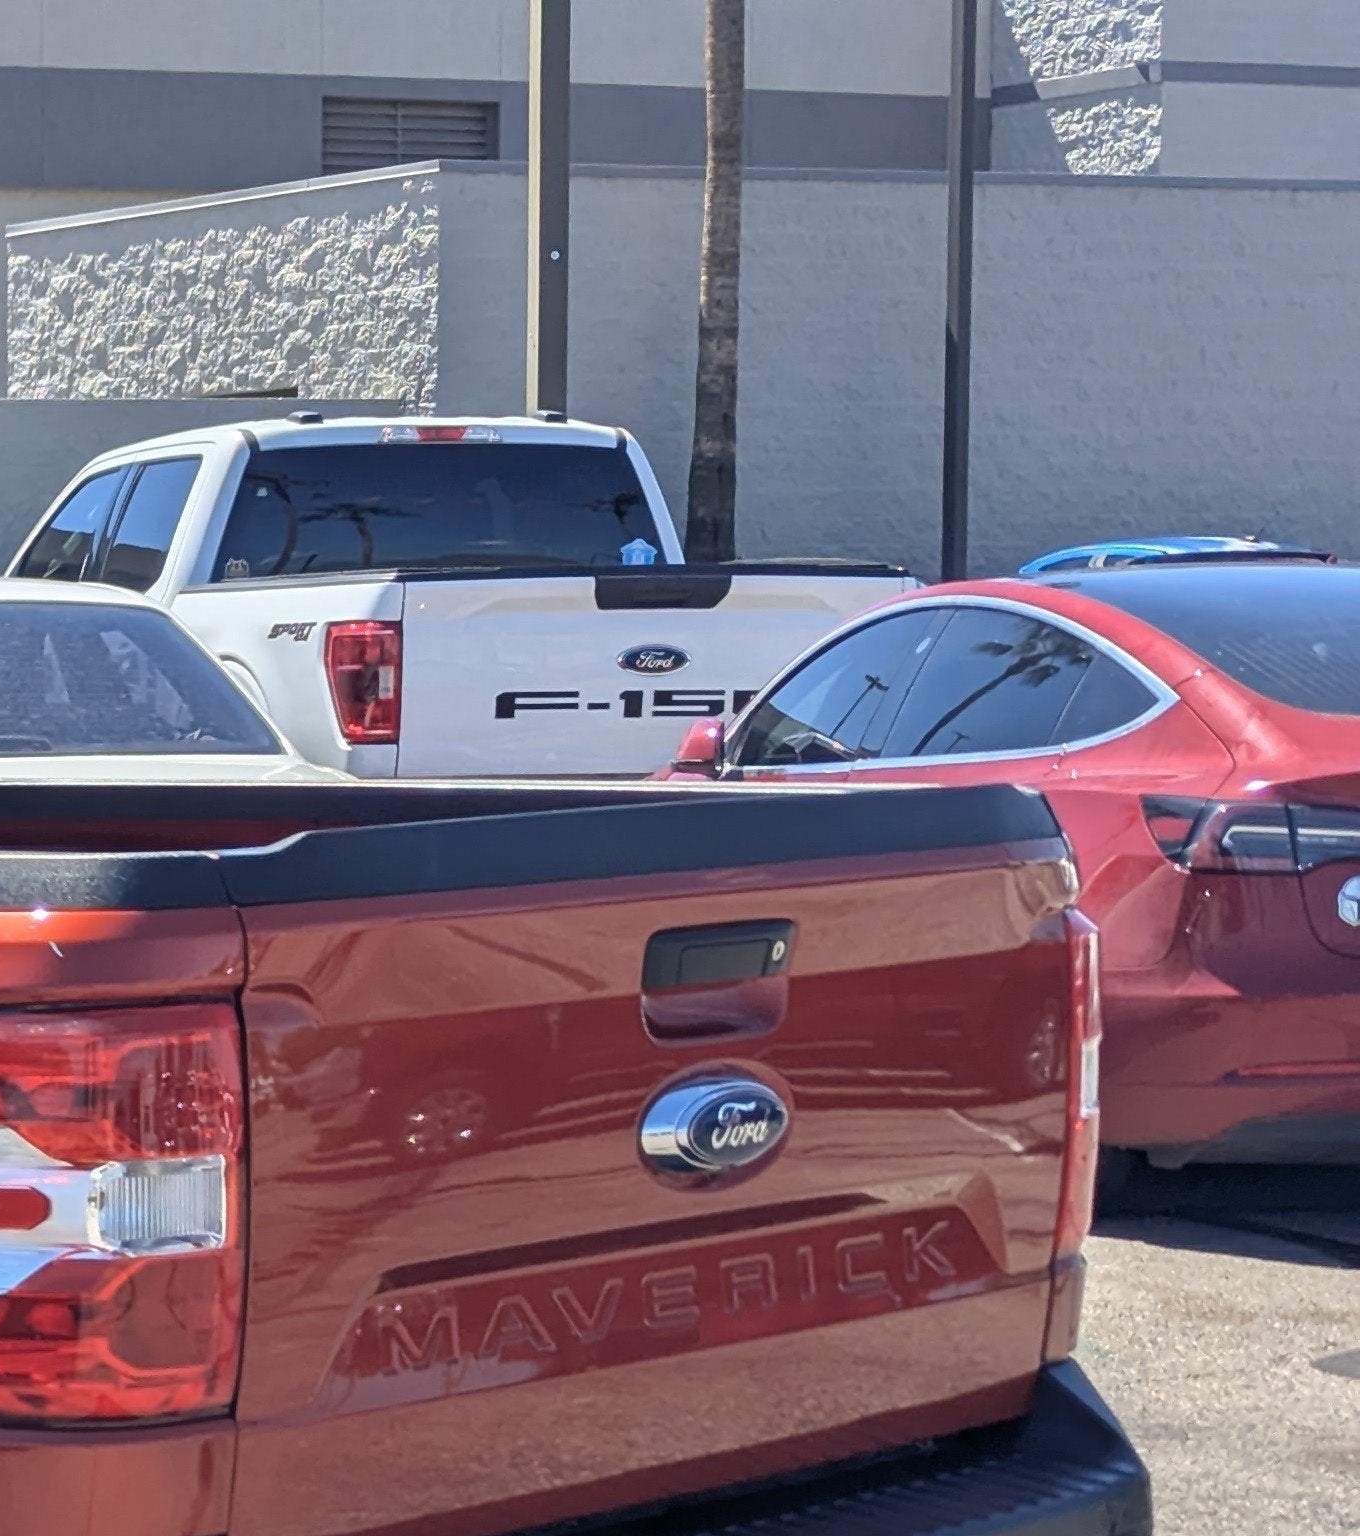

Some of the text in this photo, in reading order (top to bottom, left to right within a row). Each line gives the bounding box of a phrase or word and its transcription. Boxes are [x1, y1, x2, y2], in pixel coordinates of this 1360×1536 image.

[267, 622, 317, 641] SPORT
[635, 651, 674, 668] Ford
[711, 1101, 770, 1150] Ford
[378, 1218, 960, 1378] MAVERICK
